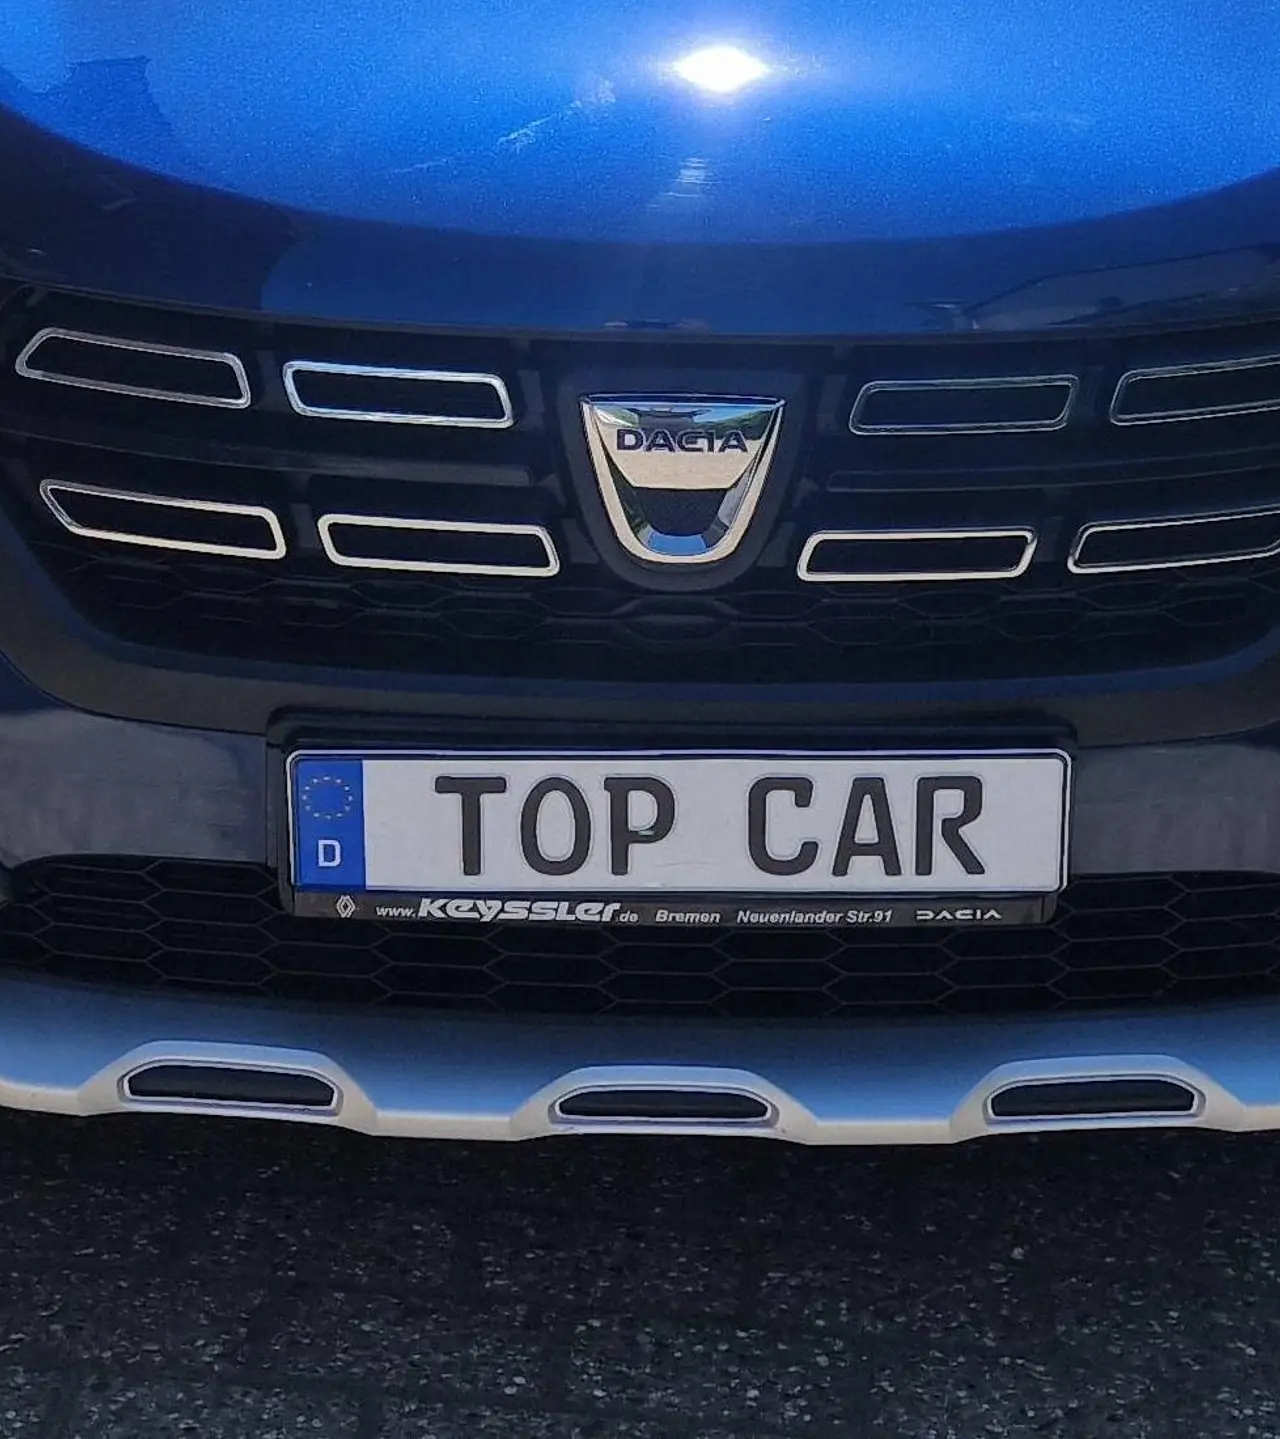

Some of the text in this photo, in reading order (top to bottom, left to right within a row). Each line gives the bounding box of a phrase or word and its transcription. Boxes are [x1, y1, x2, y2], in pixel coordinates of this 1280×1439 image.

[616, 428, 748, 452] DACIA
[434, 776, 986, 876] TOP CAR
[318, 839, 341, 867] D
[655, 909, 721, 923] Bremen
[736, 910, 843, 923] Neuenlander
[916, 908, 1002, 920] DACIA
